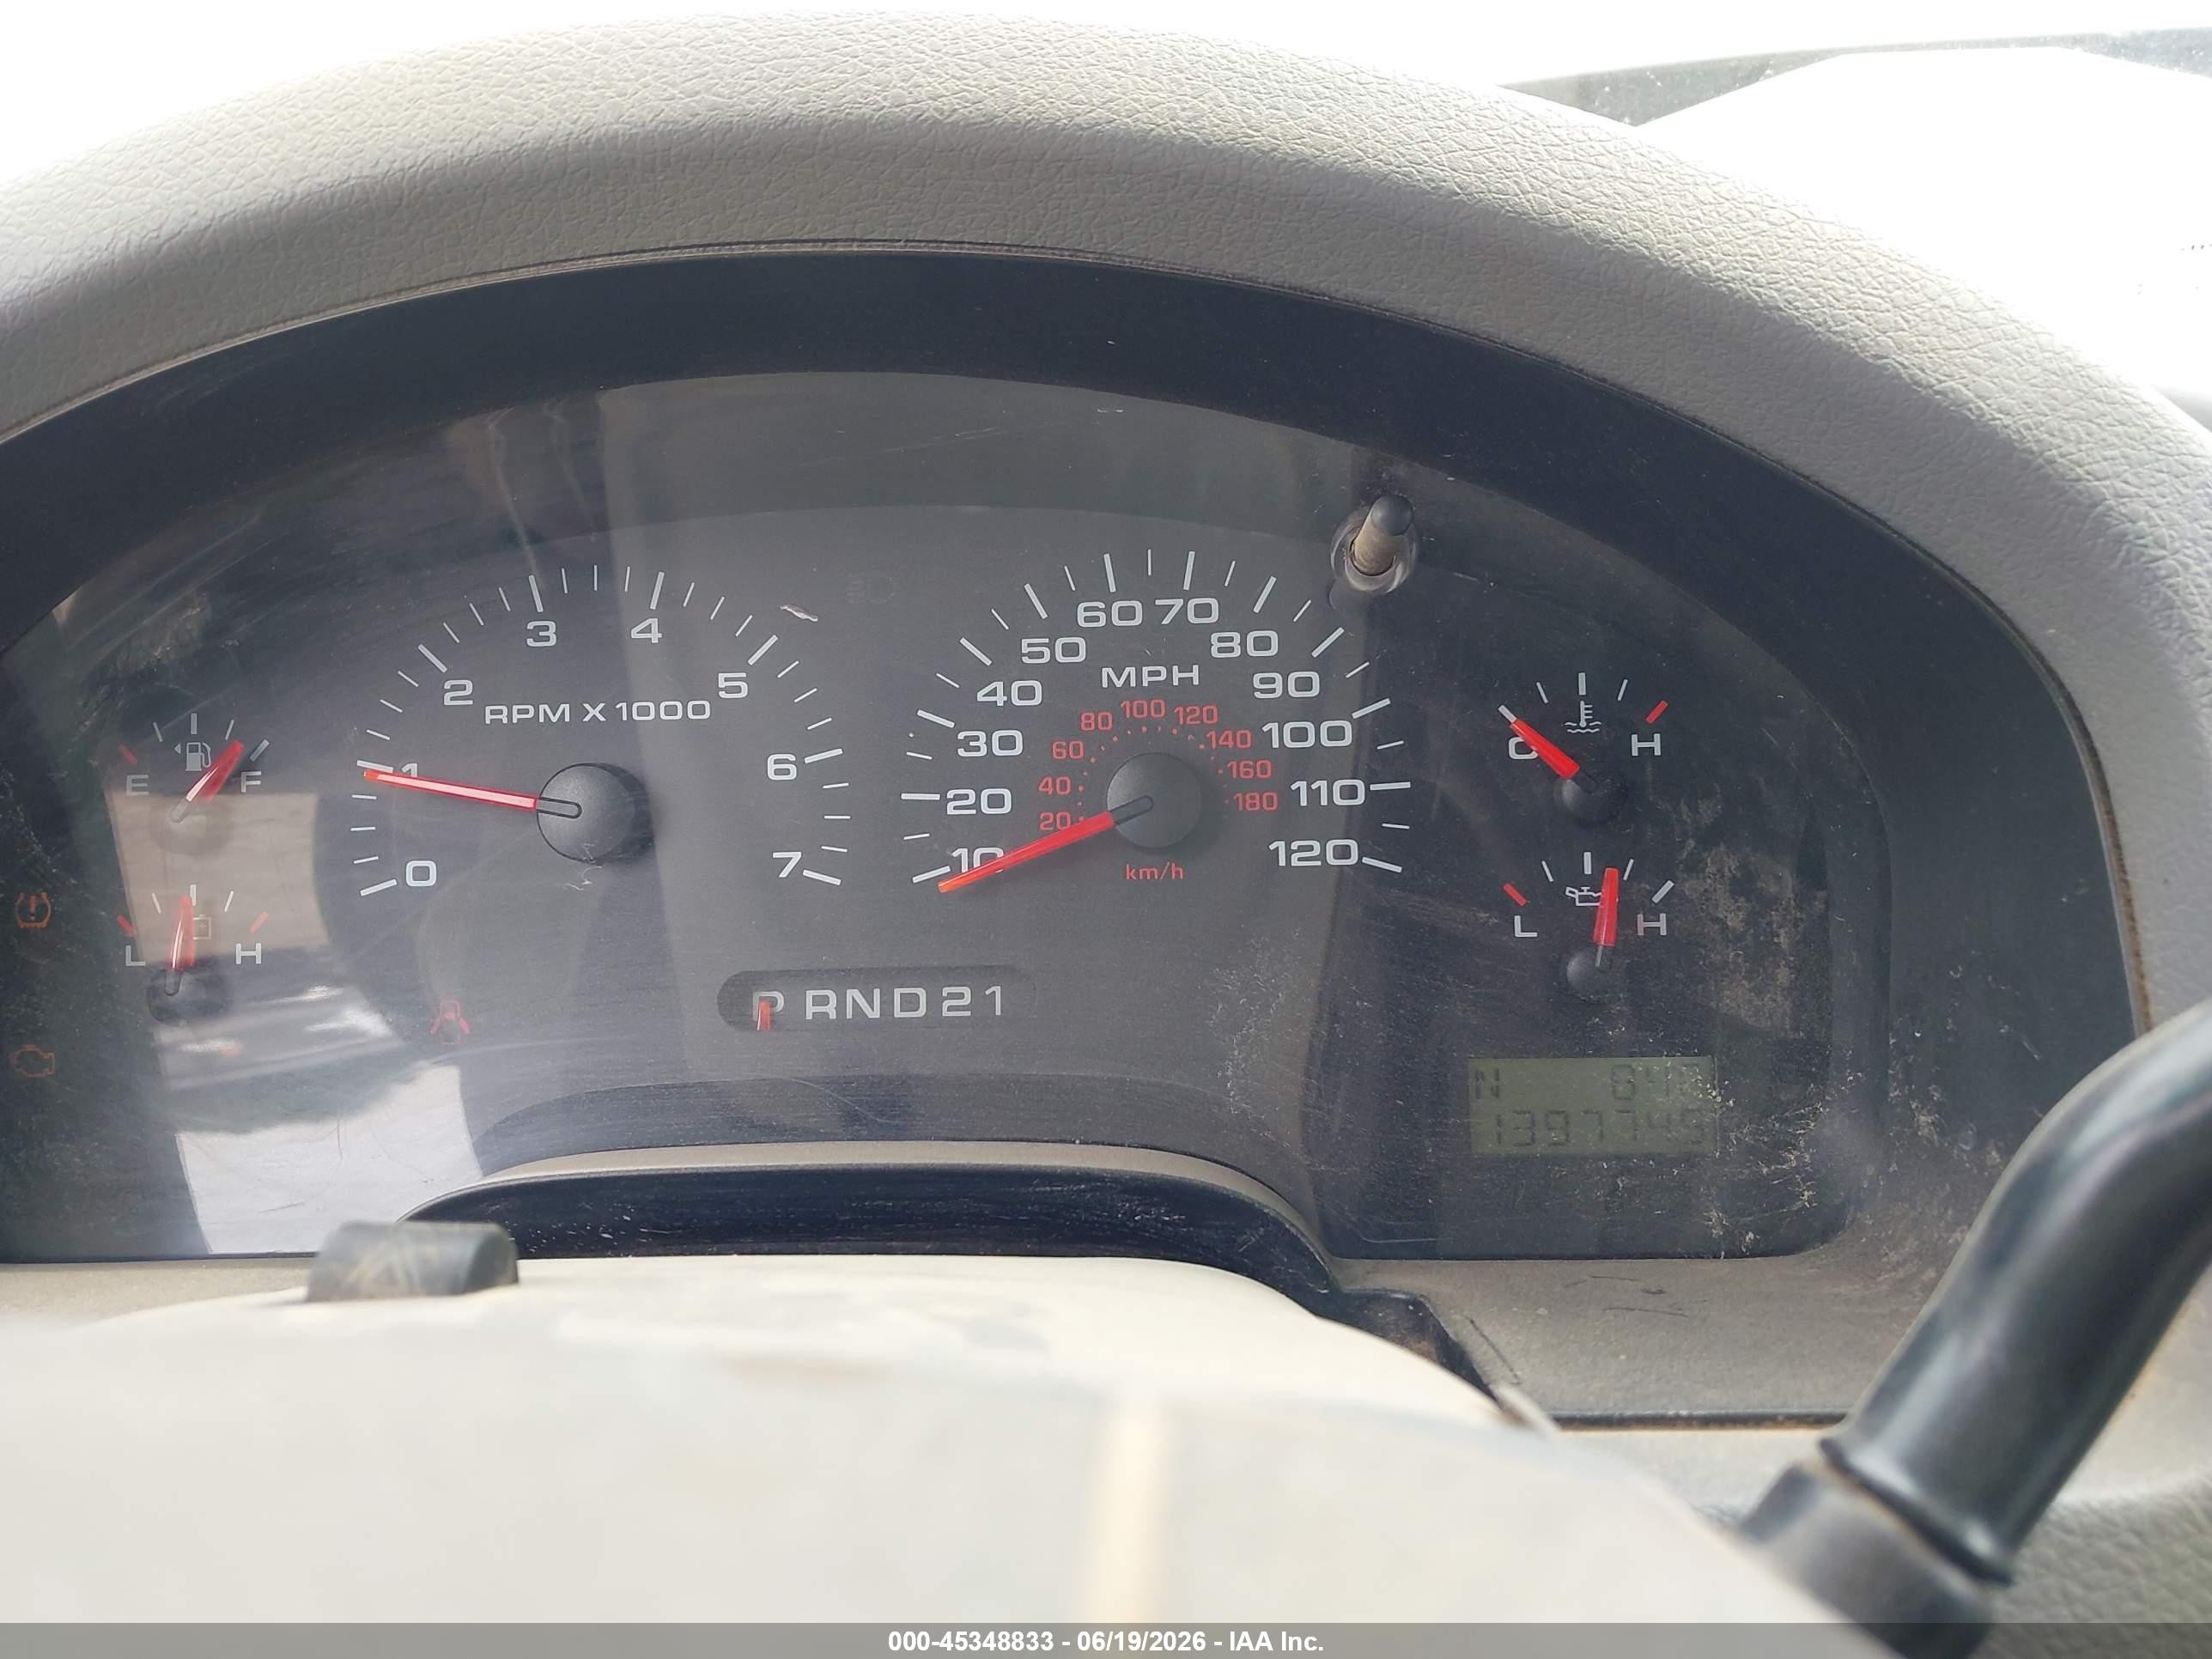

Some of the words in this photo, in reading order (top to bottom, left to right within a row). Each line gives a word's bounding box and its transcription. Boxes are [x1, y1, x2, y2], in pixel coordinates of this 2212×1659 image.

[1077, 600, 1143, 628] 60
[1154, 598, 1219, 624] 70
[527, 622, 556, 647] 3
[630, 619, 662, 643] 4
[1021, 637, 1086, 664] 50
[1211, 631, 1278, 658] 80
[718, 673, 748, 698] 5
[1102, 665, 1200, 687] MPH
[1254, 672, 1320, 699] 90
[444, 681, 473, 706] 2
[976, 681, 1043, 708] 40
[485, 704, 570, 725] RPM
[583, 703, 606, 721] X
[616, 701, 711, 721] 1000
[1121, 700, 1165, 720] 100
[1174, 705, 1218, 725] 120
[1080, 712, 1113, 732] 80
[957, 730, 1024, 757] 30
[1206, 730, 1251, 749] 140
[1262, 721, 1352, 749] 100
[1632, 733, 1662, 756] H
[1052, 740, 1085, 761] 60
[1509, 737, 1538, 759] C
[767, 755, 797, 781] 6
[1227, 760, 1272, 780] 160
[126, 775, 149, 797] E
[240, 771, 262, 793] F
[1038, 776, 1072, 795] 40
[1291, 780, 1365, 807] 110
[946, 788, 1012, 815] 20
[1234, 792, 1278, 811] 180
[1039, 811, 1072, 830] 20
[1269, 839, 1359, 867] 120
[772, 852, 802, 878] 7
[1126, 863, 1184, 881] km/h
[1514, 915, 1538, 937] L
[1638, 913, 1668, 936] H
[125, 945, 145, 966] L
[235, 943, 261, 963] H
